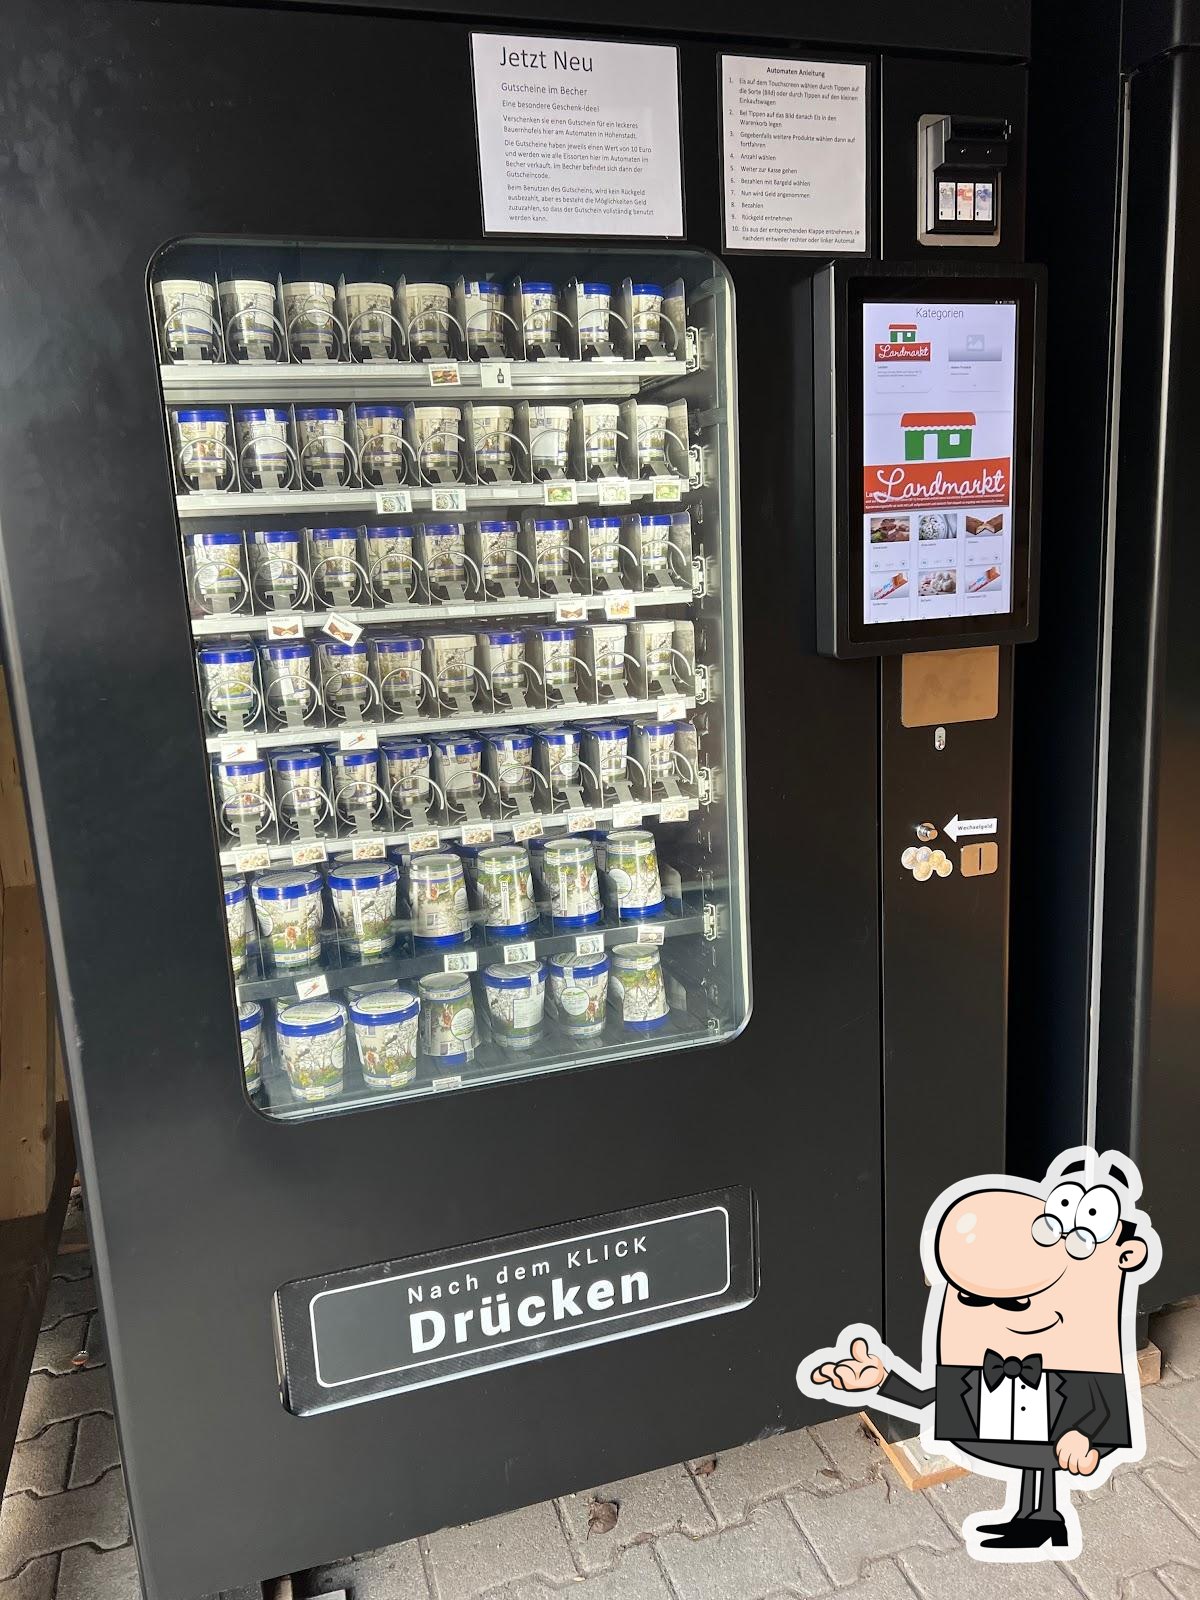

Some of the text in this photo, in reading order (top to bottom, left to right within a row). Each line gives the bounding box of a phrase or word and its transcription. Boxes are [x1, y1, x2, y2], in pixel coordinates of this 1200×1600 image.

[500, 46, 593, 71] Jetzt Neu
[799, 69, 824, 78] Anleitung
[501, 83, 546, 93] Gutscheine
[560, 86, 588, 95] Becher
[916, 308, 964, 320] Kategorien
[878, 344, 929, 358] Landmarkt
[876, 468, 1005, 502] Landmarkt
[407, 1236, 648, 1304] Nach dem KLICK
[409, 1270, 650, 1354] Drücken
